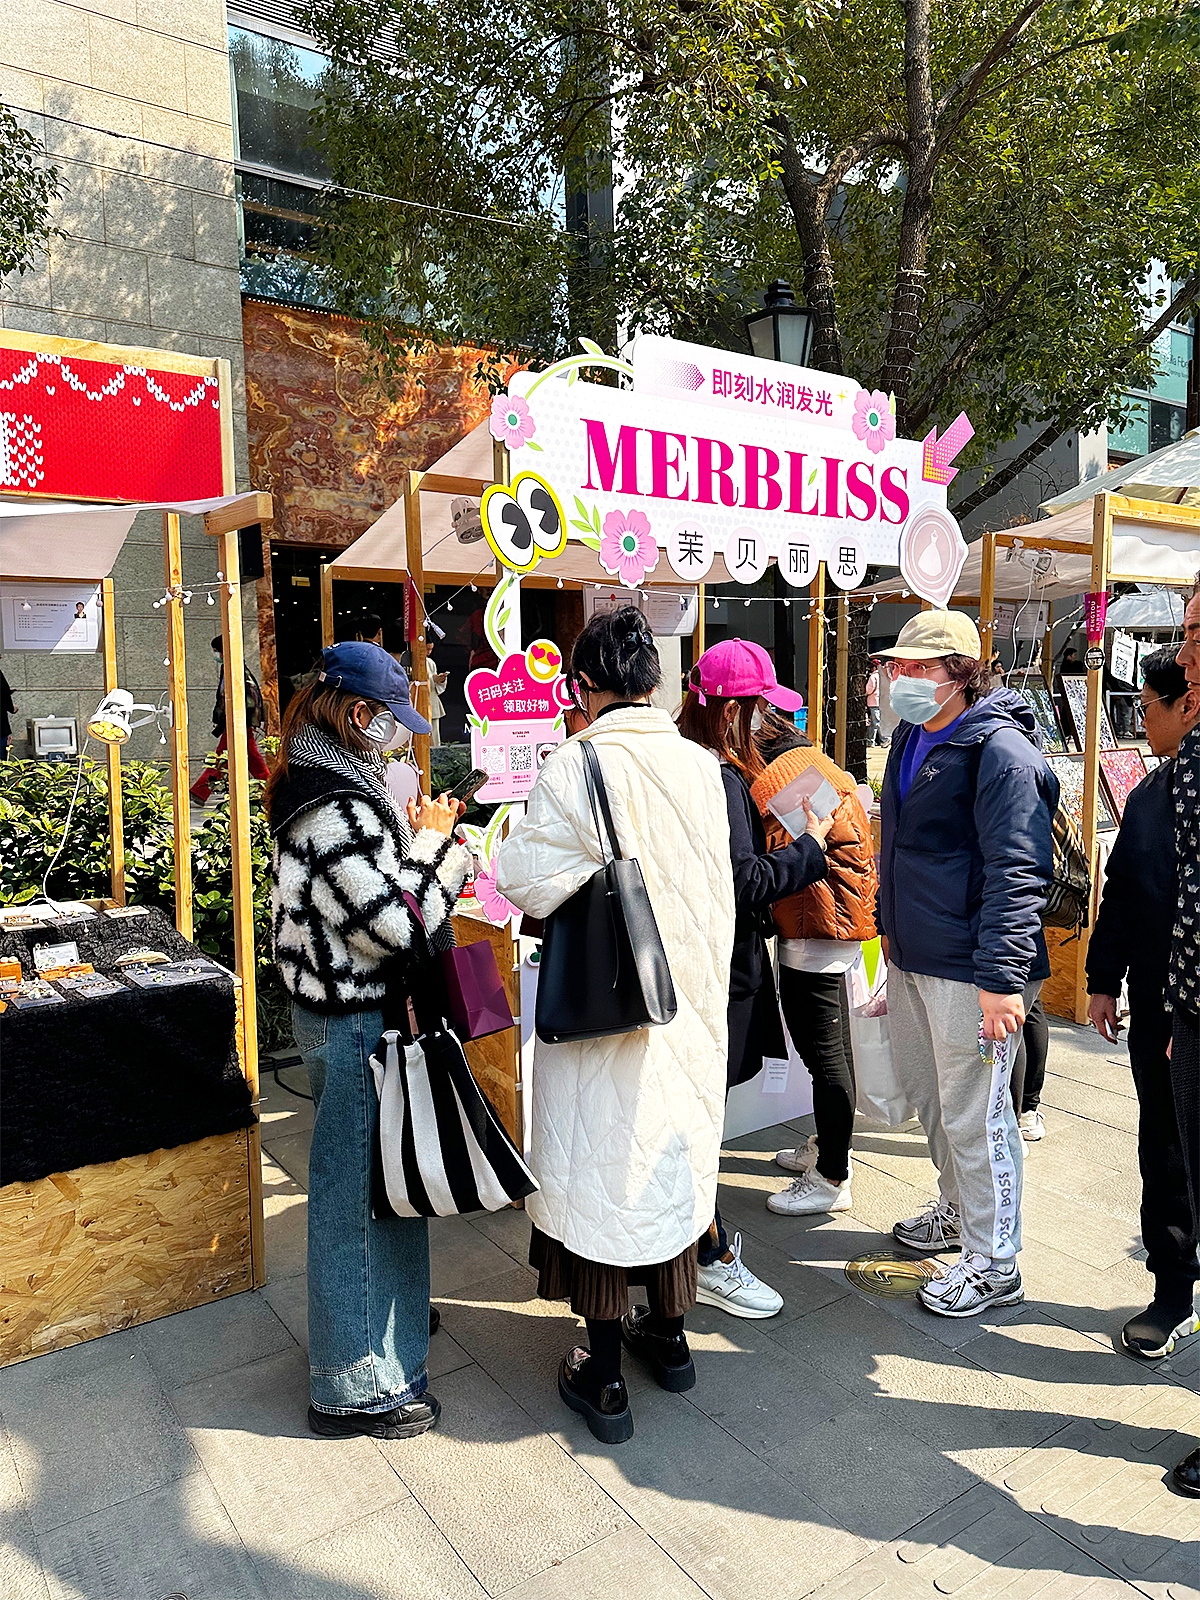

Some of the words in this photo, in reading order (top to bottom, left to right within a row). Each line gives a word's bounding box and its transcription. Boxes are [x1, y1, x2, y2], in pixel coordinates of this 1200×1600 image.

[711, 368, 834, 417] 即刻水润发光
[580, 418, 911, 525] MERBLISS
[677, 531, 859, 577] 茉贝丽思
[478, 678, 525, 702] 扫码关注
[503, 699, 549, 713] 领取好物
[993, 1127, 1006, 1162] BOSS
[998, 1172, 1011, 1208] BOSS
